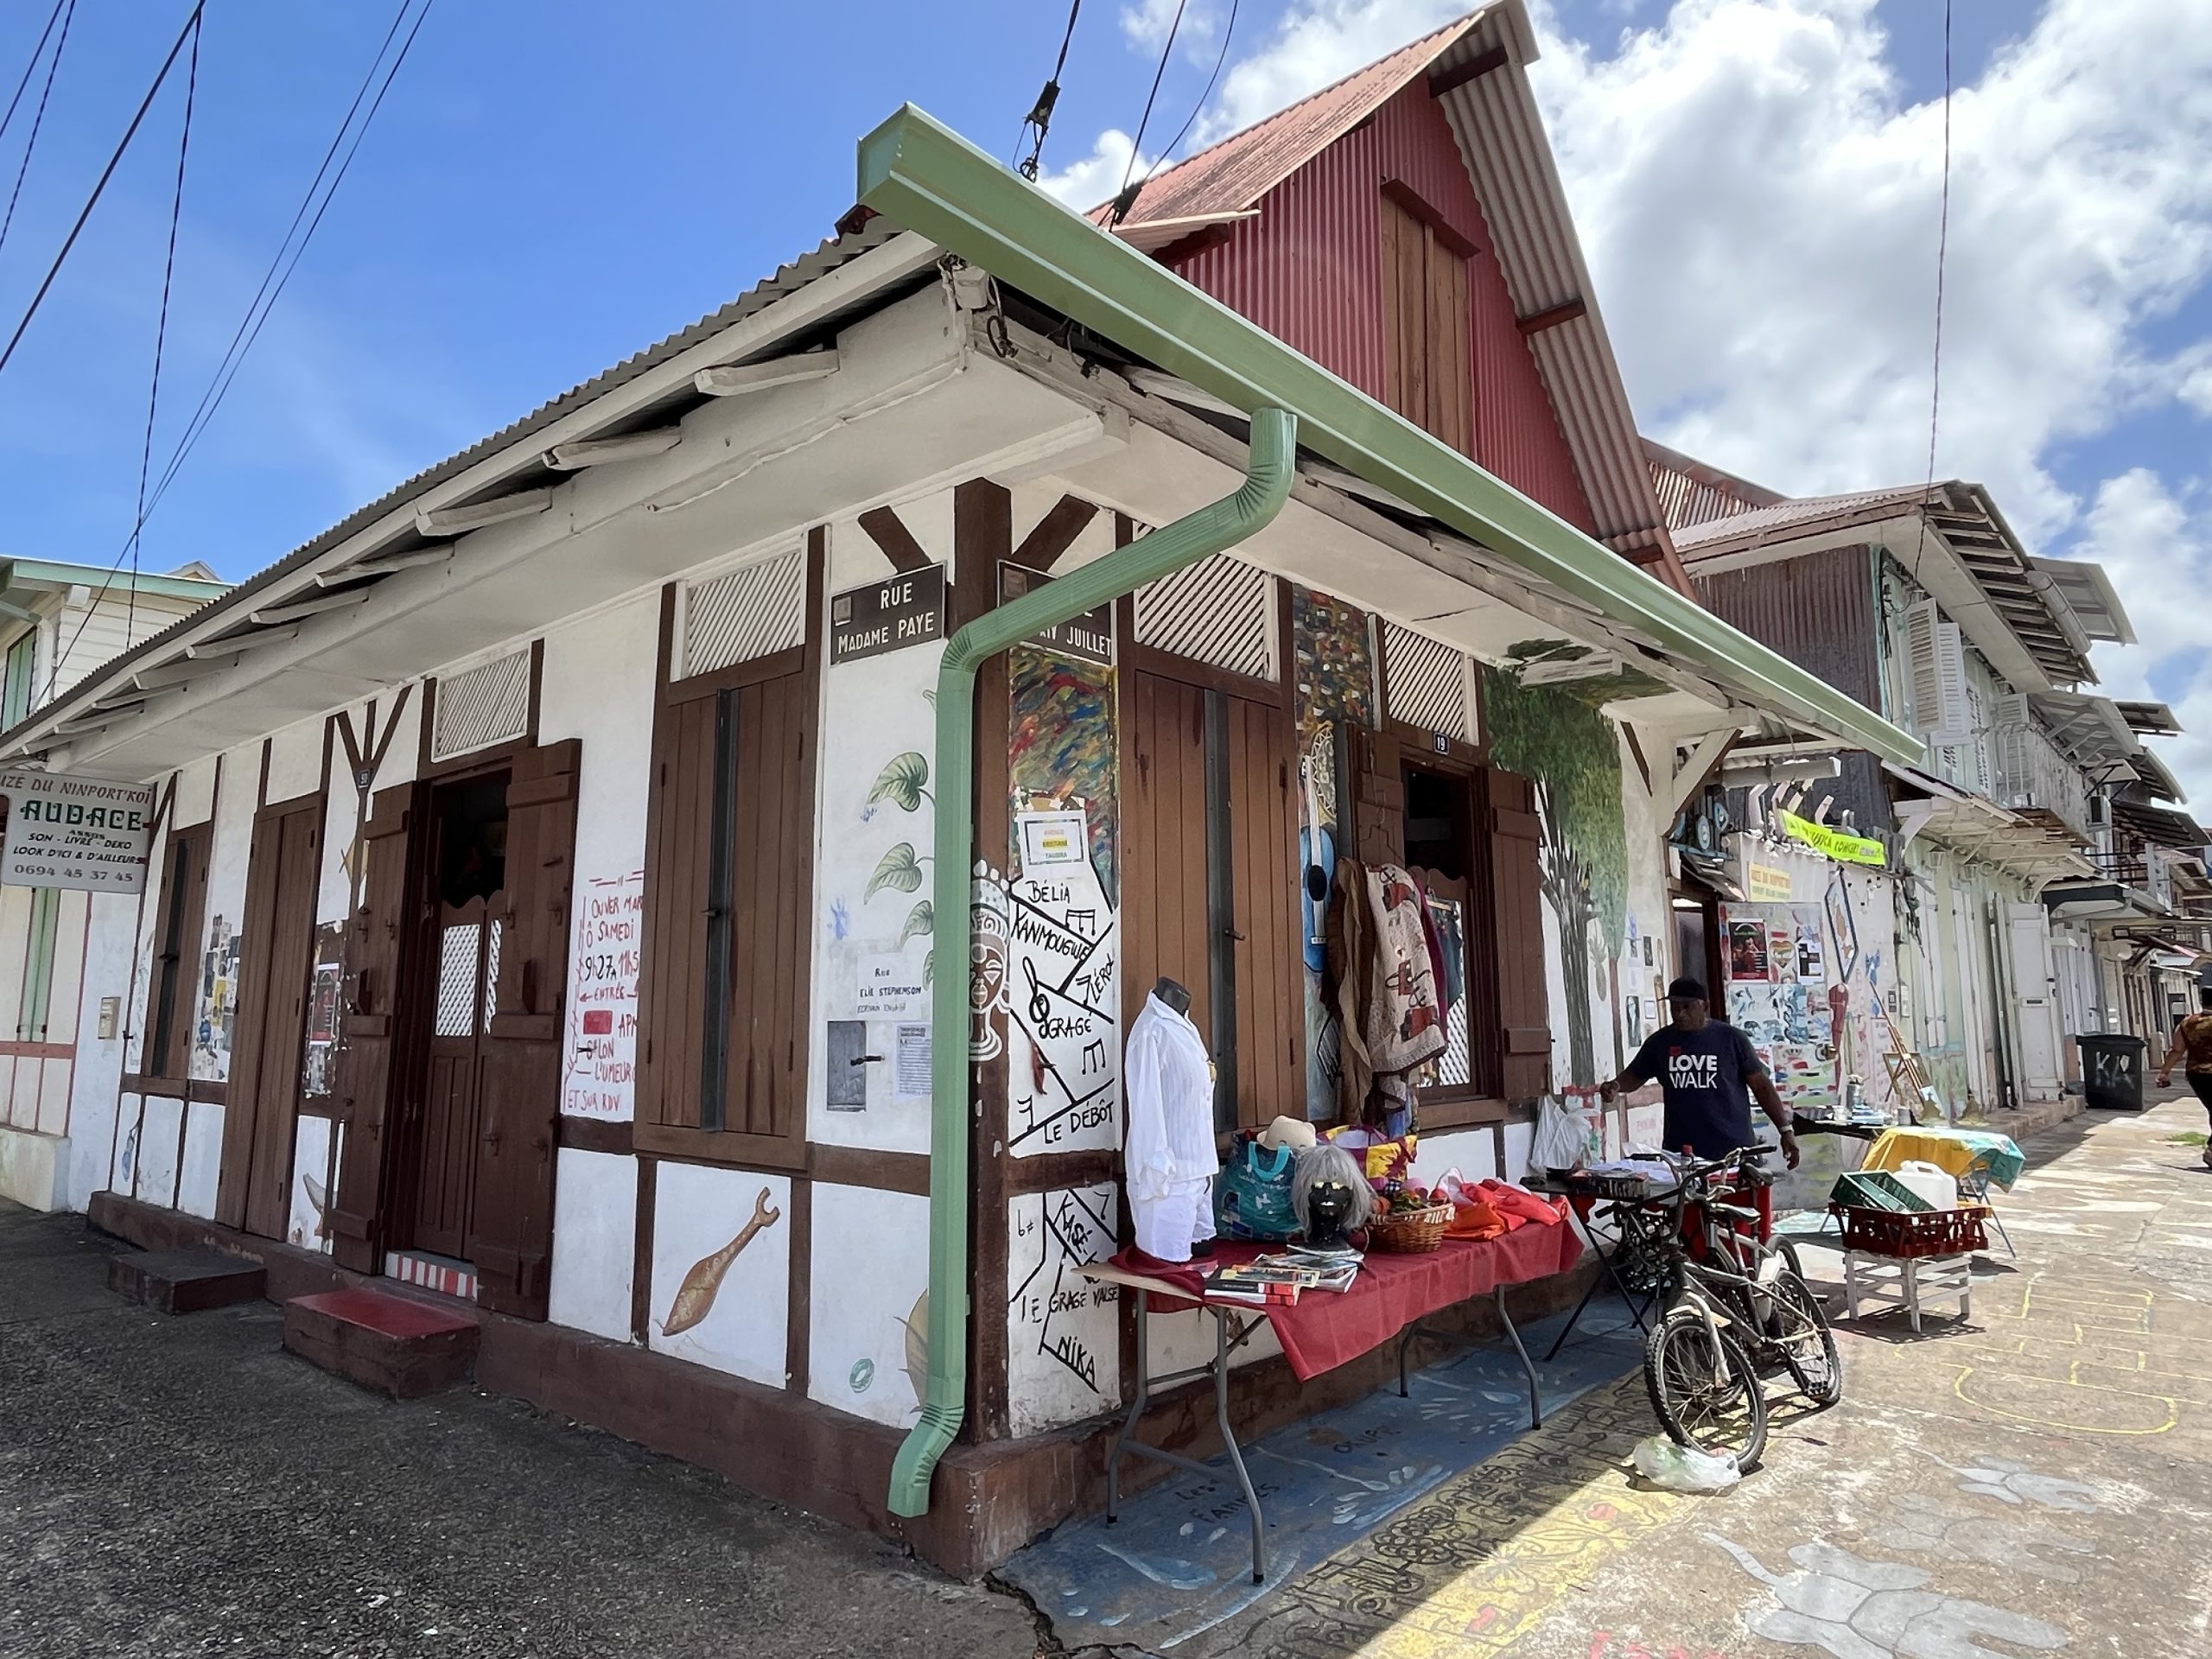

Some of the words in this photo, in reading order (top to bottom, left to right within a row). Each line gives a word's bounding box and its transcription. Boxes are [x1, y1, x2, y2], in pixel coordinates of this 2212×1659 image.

[880, 582, 912, 609] RUE
[838, 626, 888, 654] MADAME
[898, 612, 934, 639] PAYE
[1066, 626, 1111, 657] JUILLET
[1437, 736, 1446, 751] 19
[31, 779, 54, 792] DU
[20, 799, 143, 831] AUDACE
[28, 833, 54, 842] SON
[104, 840, 132, 849] DEKO
[13, 846, 43, 856] LOOK
[48, 849, 72, 858] D'ICI
[14, 864, 55, 876] 0694
[64, 868, 82, 878] 45
[90, 870, 108, 880] 37
[115, 872, 133, 882] 45
[1669, 1054, 1718, 1071] LOVE
[1669, 1071, 1718, 1089] WALK
[1044, 1123, 1062, 1144] LE
